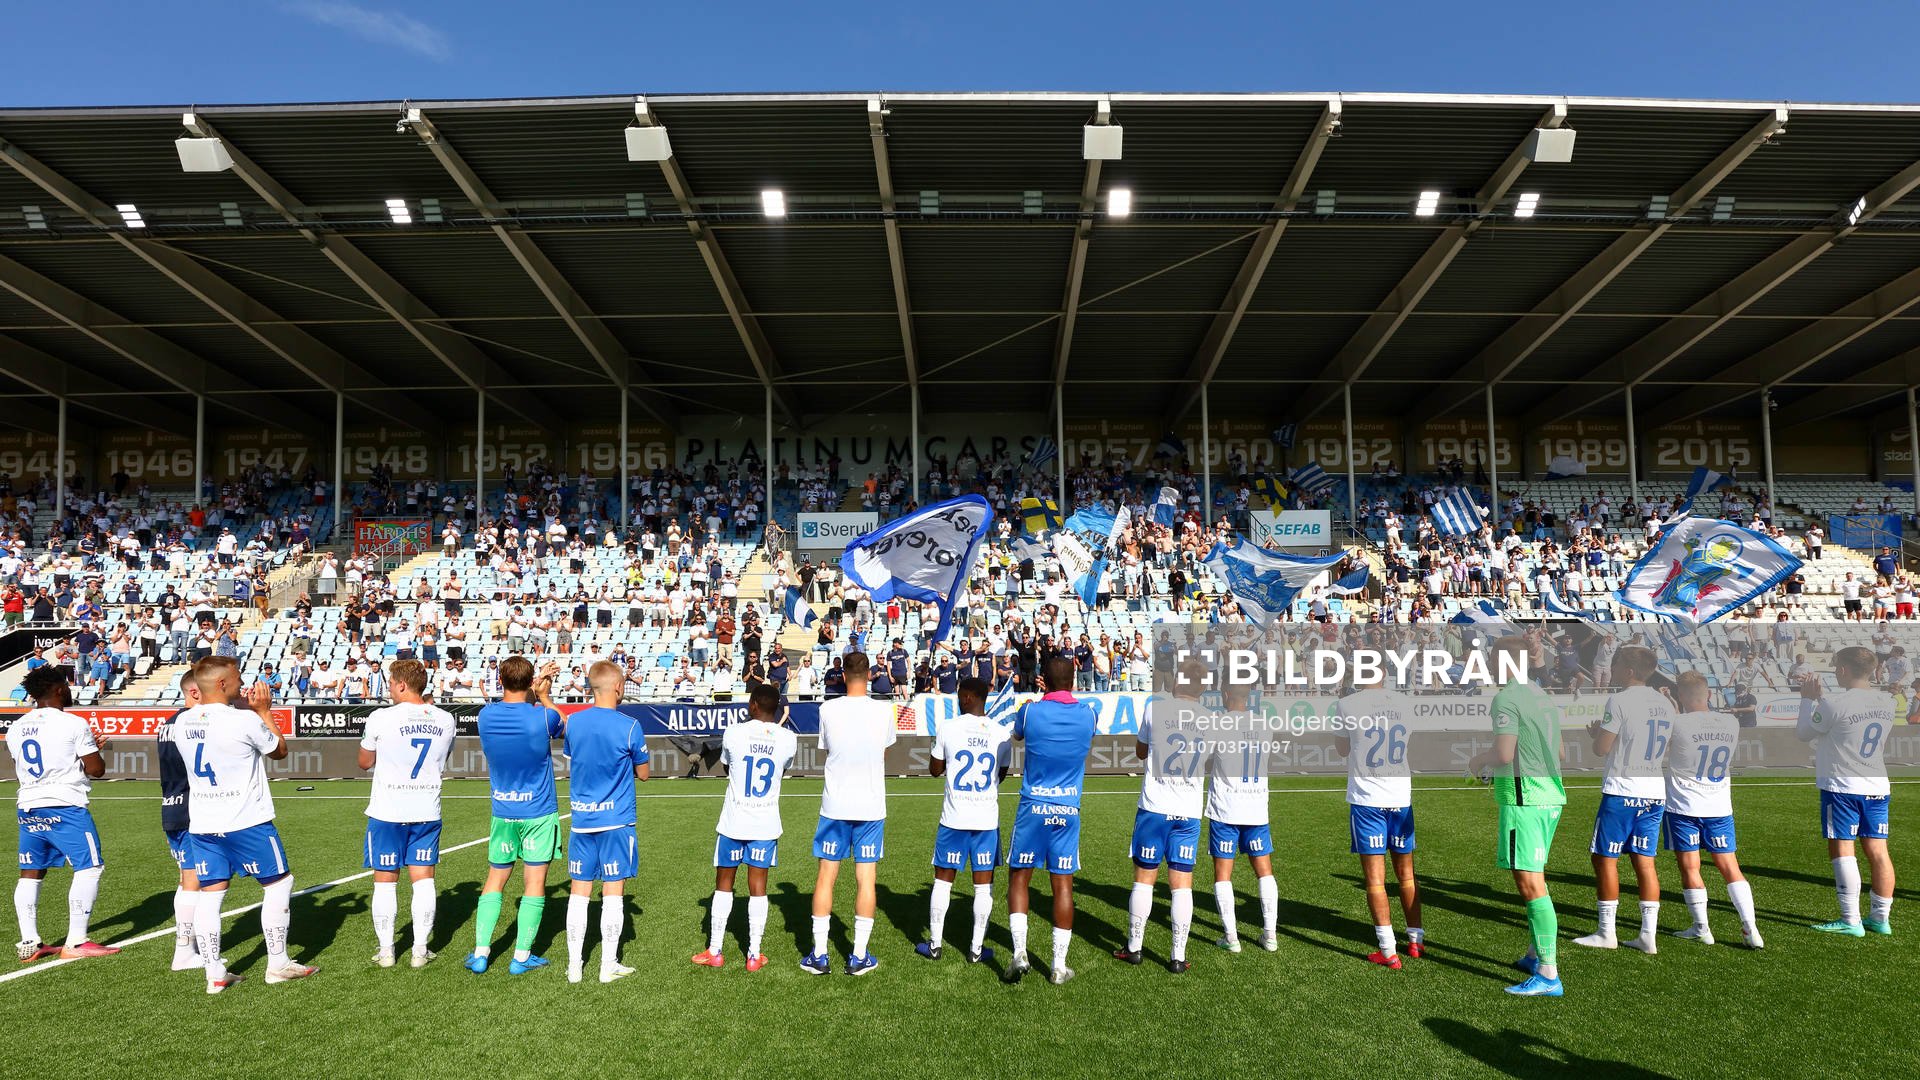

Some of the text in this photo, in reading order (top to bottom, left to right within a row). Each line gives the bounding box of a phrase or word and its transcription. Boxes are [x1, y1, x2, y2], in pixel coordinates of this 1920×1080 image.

[342, 445, 427, 474] 1948
[458, 443, 547, 473] 1952
[576, 442, 667, 471] 1956
[1064, 438, 1151, 467] 1957
[1182, 438, 1274, 467] 1960
[1302, 438, 1393, 466] 1962
[1422, 438, 1511, 466] 1963
[1539, 438, 1627, 466] 1989
[1657, 438, 1750, 466] 2015
[1883, 450, 1912, 462] stad
[0, 450, 77, 479] 945
[105, 449, 194, 477] 1946
[224, 447, 308, 476] 1947
[821, 522, 873, 537] Sverull
[1274, 523, 1321, 536] SEFAB
[411, 542, 428, 552] AB
[89, 711, 166, 734] ÅBY FA
[300, 713, 346, 728] KSAB
[352, 716, 369, 724] KON
[669, 708, 748, 731] ALLSVENS
[1848, 710, 1893, 725] JOHANNESS
[21, 727, 39, 737] SAM
[185, 730, 206, 740] LUND
[399, 724, 443, 737] FRANSSON
[967, 737, 989, 749] SEMA
[1364, 724, 1407, 768] 26
[1644, 719, 1670, 761] 15
[1860, 722, 1883, 759] 8
[750, 743, 774, 756] ISHAQ
[22, 739, 44, 779] 9
[194, 742, 218, 787] 4
[410, 738, 432, 780] 7
[1241, 742, 1262, 783] 11
[1695, 744, 1730, 783] 18
[742, 755, 775, 798] 13
[953, 749, 996, 793] 23
[388, 784, 440, 793] PLATINUMCAR
[1030, 785, 1078, 798] stadium
[570, 799, 614, 812] stadium
[1031, 803, 1079, 816] MÅNSSON
[1044, 815, 1067, 826] RÖR
[823, 841, 838, 856] nt
[1219, 839, 1234, 853] nt
[1249, 837, 1264, 851] nt
[1369, 833, 1385, 849] nt
[1608, 840, 1624, 853] nt
[1632, 835, 1649, 850] nt
[1711, 834, 1728, 849] nt
[415, 848, 432, 862] nt
[751, 847, 766, 862] nt
[860, 843, 876, 859] nt
[947, 851, 962, 865] nt
[977, 850, 992, 865] nt
[1019, 851, 1034, 864] nt
[1141, 846, 1157, 860] nt
[1179, 844, 1194, 860] nt
[380, 852, 397, 866] nt
[1058, 855, 1074, 870] nt
[603, 860, 620, 876] nt
